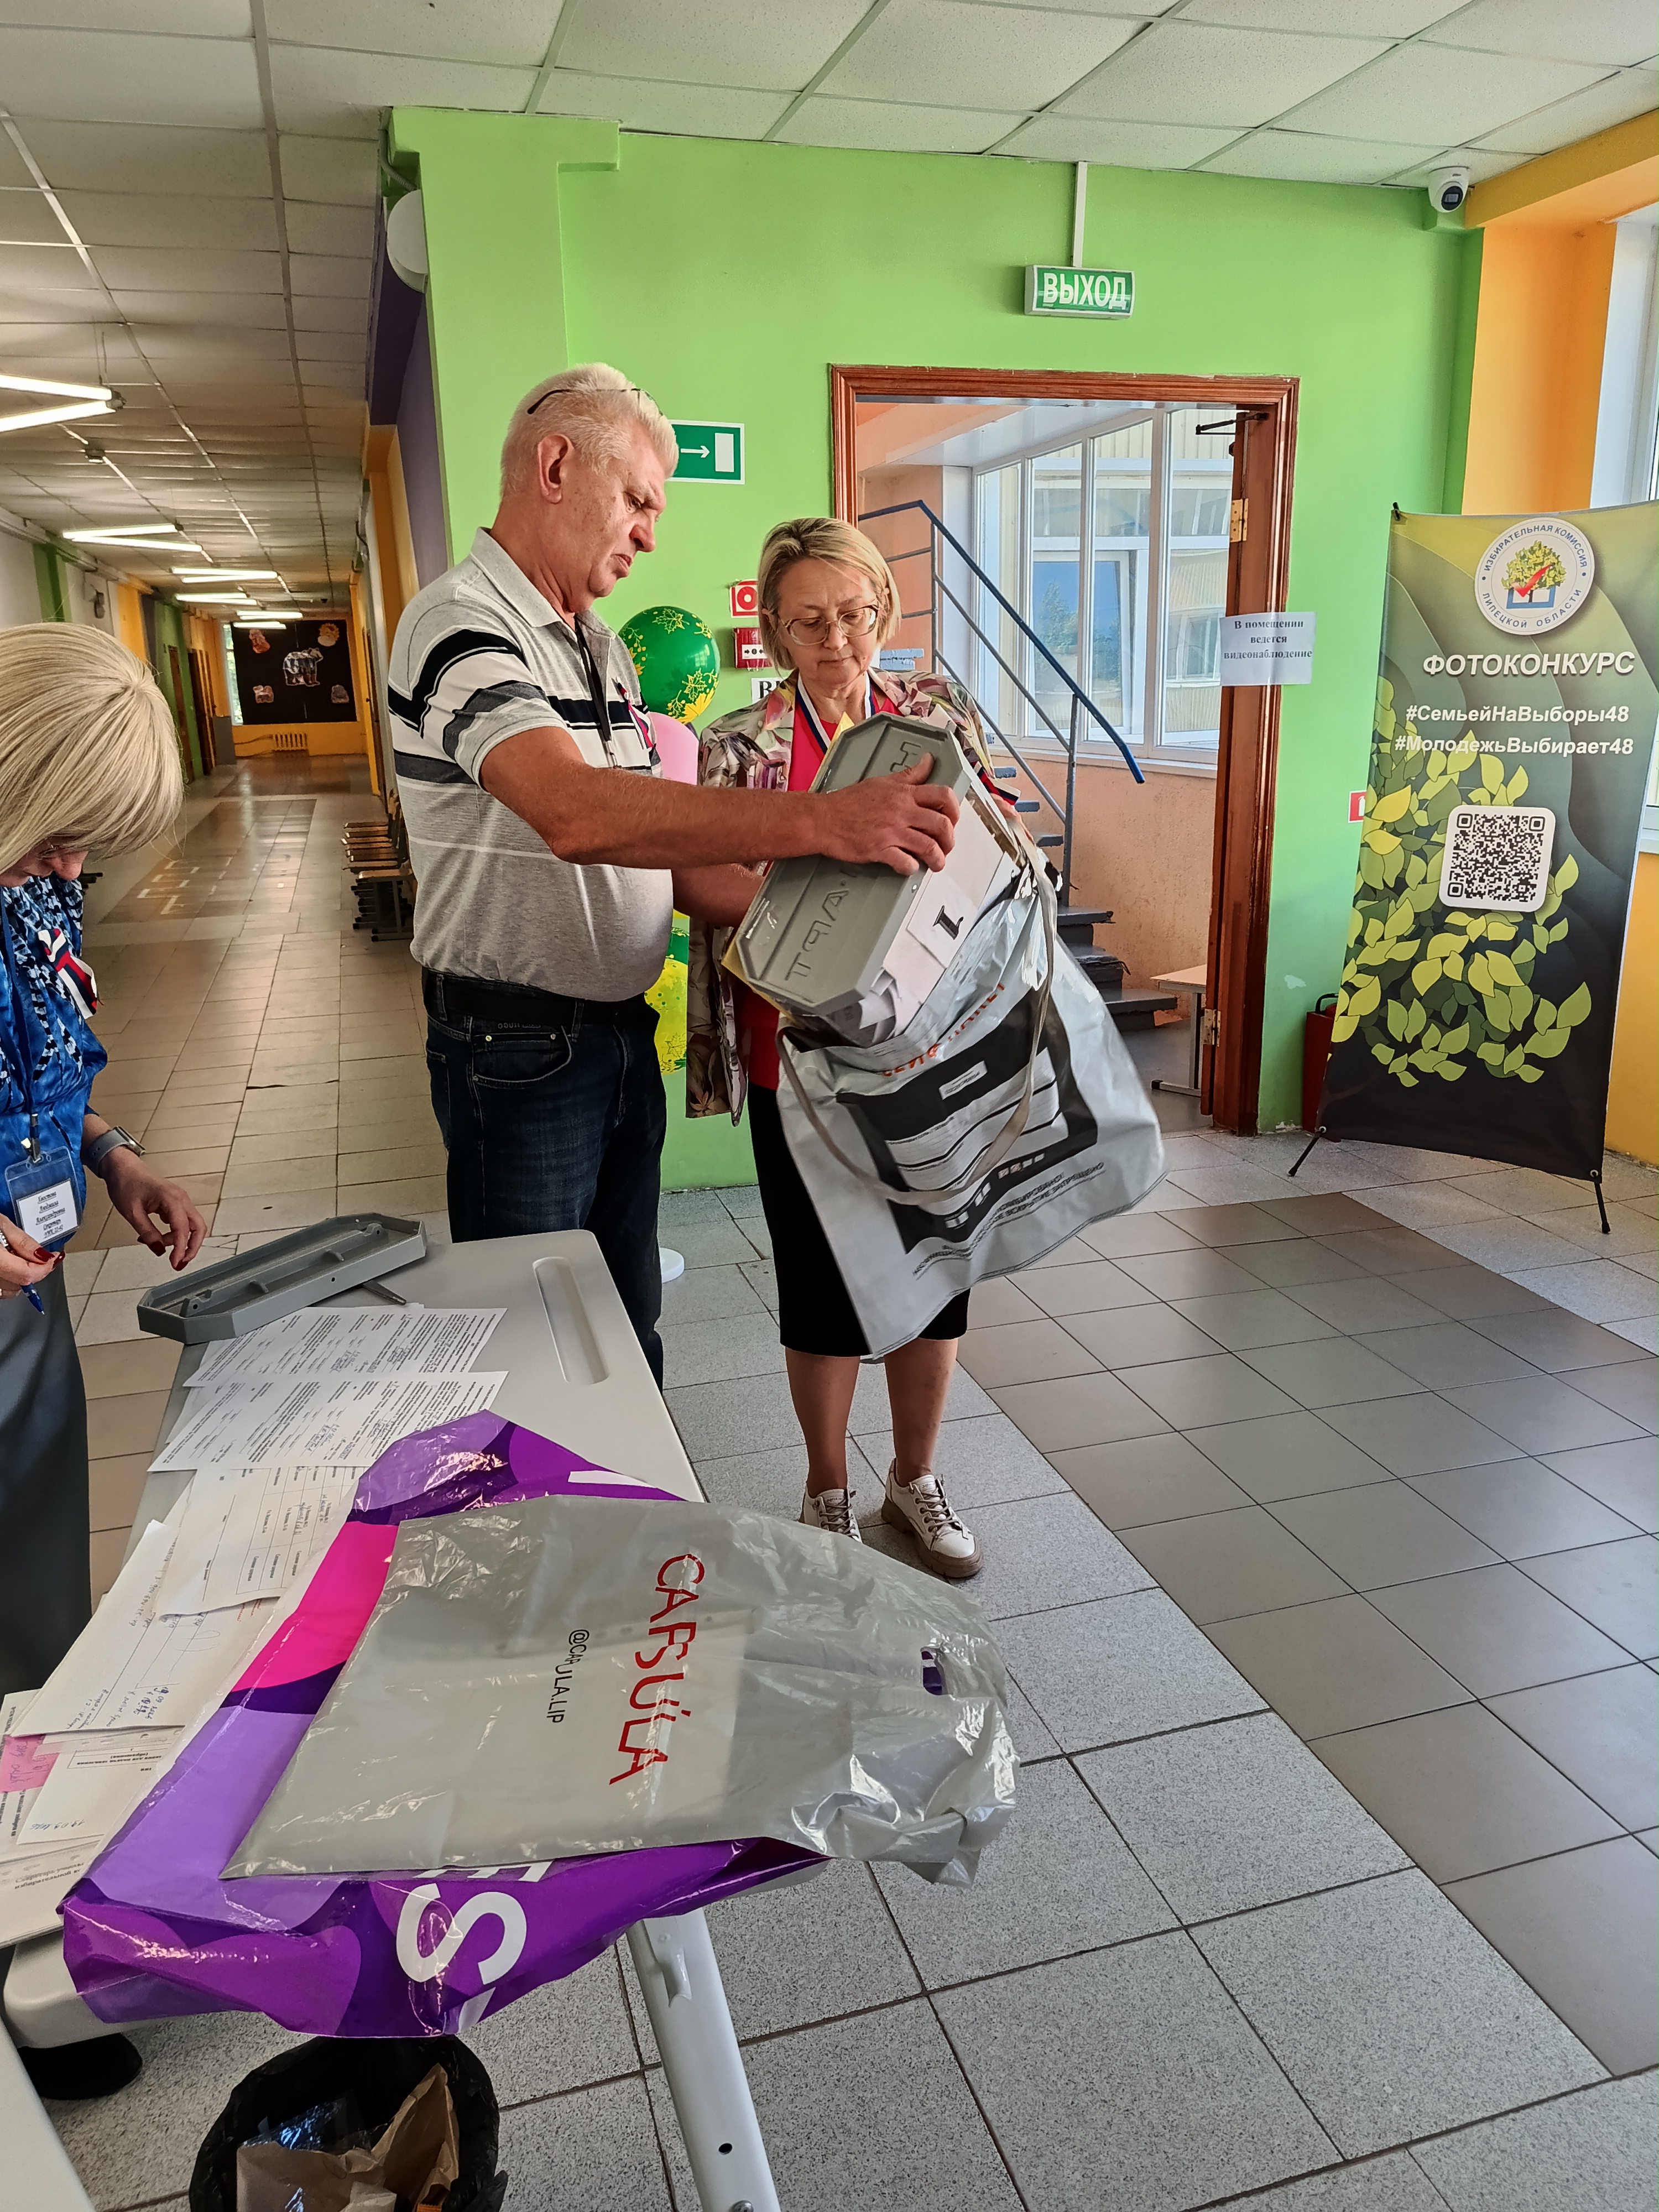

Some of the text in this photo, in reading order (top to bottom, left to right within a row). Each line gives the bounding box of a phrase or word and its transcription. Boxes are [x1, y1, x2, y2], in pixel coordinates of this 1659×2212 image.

[1043, 273, 1127, 310] ВЫХОД
[1484, 525, 1588, 571] ИЗБИРАТЕЛЬНАЯ КОМИССИЯ
[1483, 589, 1582, 628] ЛИПЕЦКОЙ ОБЛАСТИ
[1234, 620, 1304, 629] В помещении
[1224, 649, 1312, 659] видеонаблюдение
[1423, 651, 1635, 676] ФОТОКОНКУРС
[1406, 705, 1629, 725] #СемьейНаВыборы48
[1395, 735, 1634, 757] #МолодежьВыбирает48
[546, 1629, 590, 1723] @CAPULA.LIP
